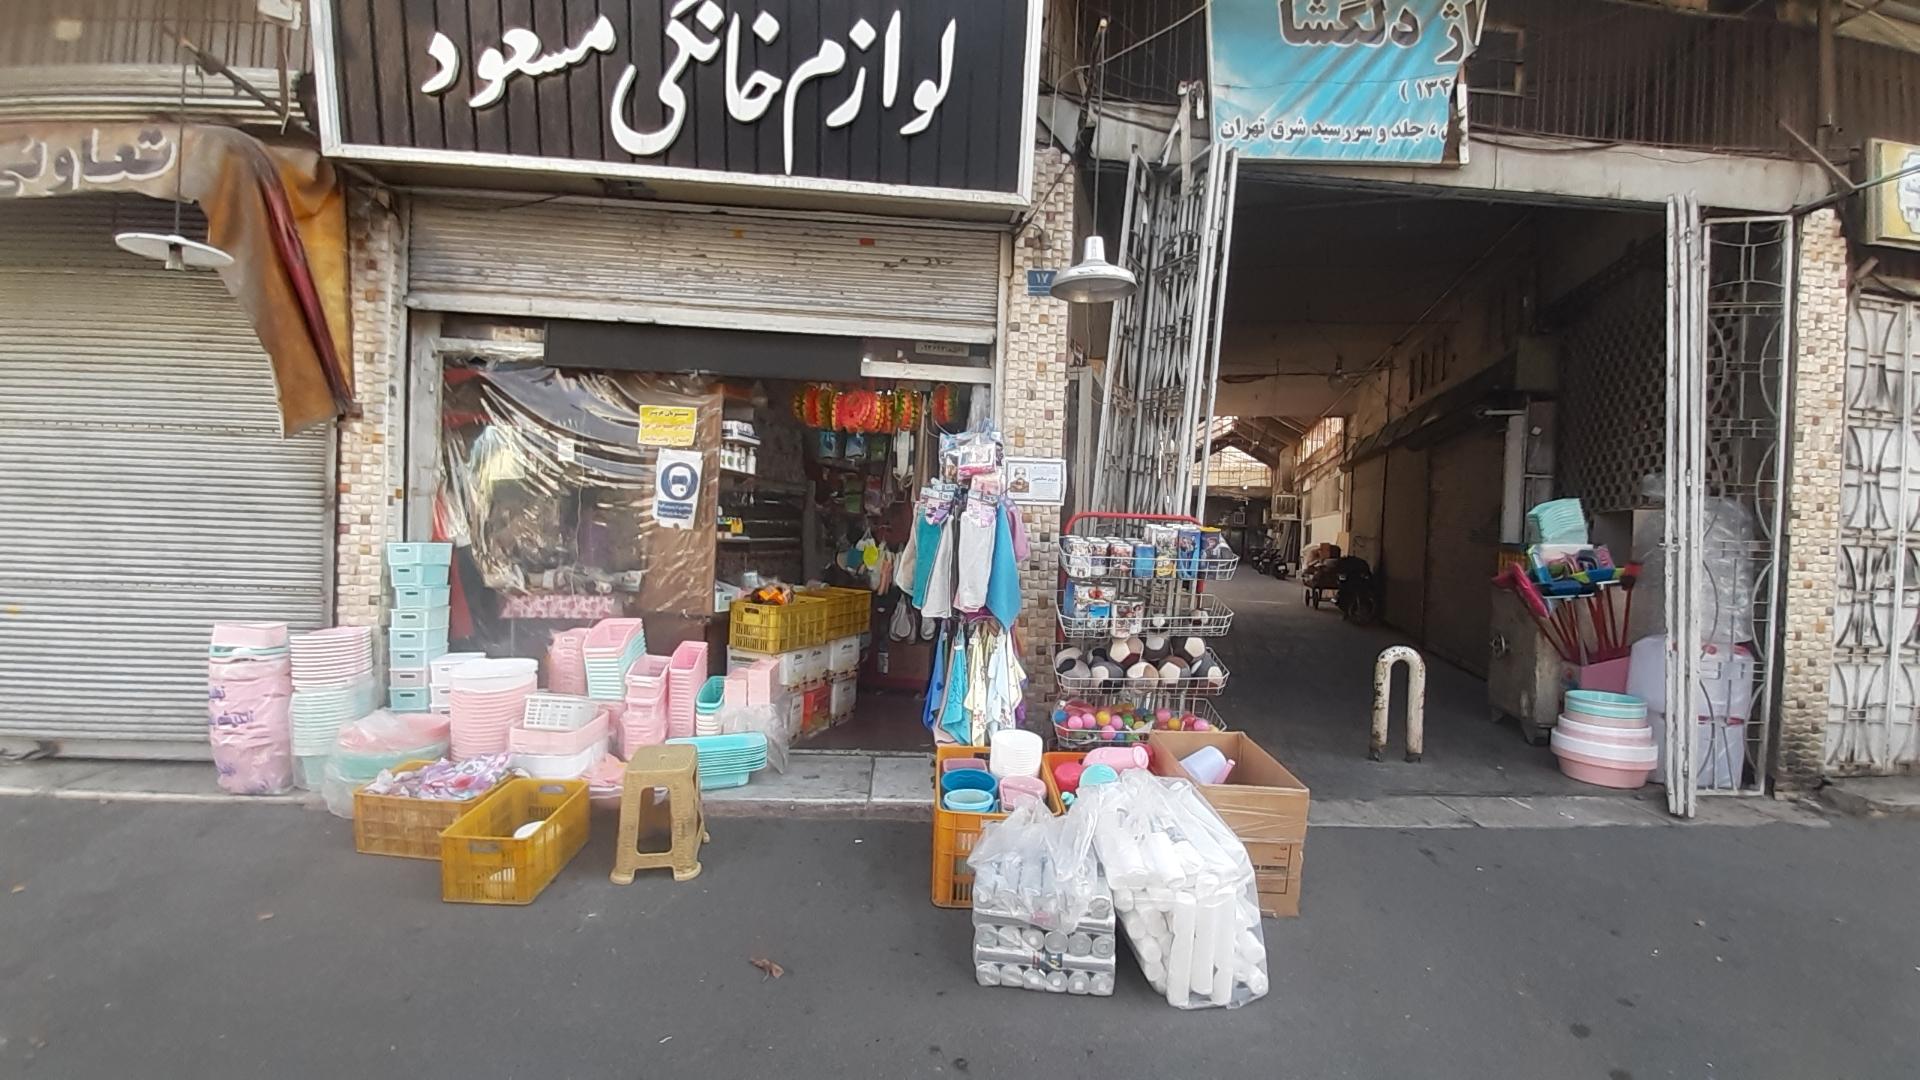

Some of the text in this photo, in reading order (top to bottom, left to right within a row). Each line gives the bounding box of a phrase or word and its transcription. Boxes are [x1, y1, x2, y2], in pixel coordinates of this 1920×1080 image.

[421, 0, 958, 176] لوازم خانگی مسعود
[1416, 78, 1452, 98] ۱۳۴
[1220, 117, 1266, 140] تهران
[1270, 118, 1307, 141] شرق
